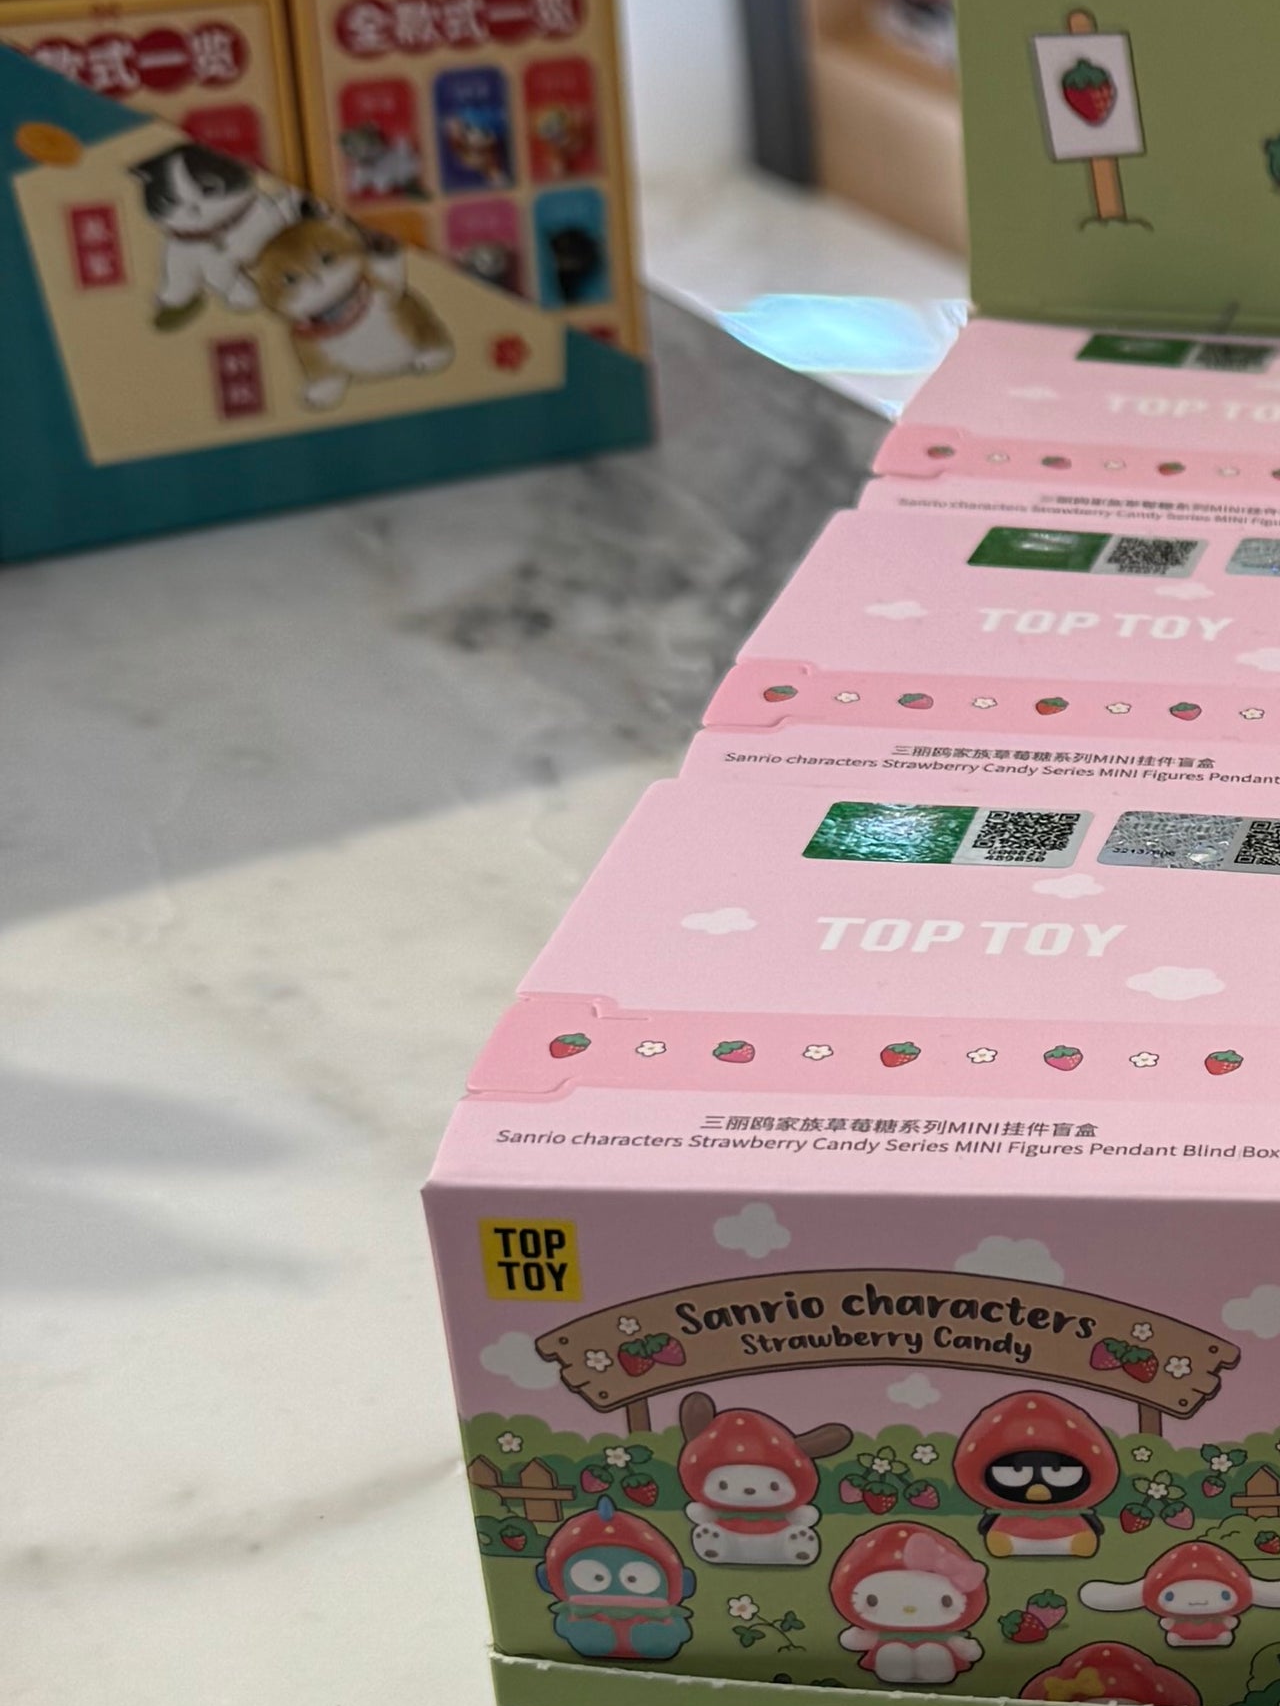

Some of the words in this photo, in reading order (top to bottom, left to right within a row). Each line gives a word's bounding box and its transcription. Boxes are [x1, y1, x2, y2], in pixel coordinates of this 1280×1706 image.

[1105, 394, 1206, 419] TOP
[978, 607, 1100, 637] TOP
[1112, 611, 1234, 641] TOY
[724, 753, 782, 764] Sanrio
[786, 755, 877, 768] characters
[882, 759, 979, 776] Strawberry
[982, 763, 1038, 779] Candy
[1042, 765, 1095, 777] Series
[1098, 768, 1138, 779] MINI
[1142, 769, 1204, 784] Figures
[1209, 772, 1280, 785] Pendant
[818, 917, 964, 955] TOP
[980, 919, 1128, 959] TOY
[497, 1130, 566, 1144] Sanrio
[571, 1131, 683, 1146] characters
[689, 1134, 807, 1154] Strawberry
[813, 1136, 880, 1155] Candy
[886, 1138, 949, 1152] Series
[955, 1139, 1002, 1153] MINI
[1008, 1141, 1083, 1158] Figures
[1089, 1142, 1176, 1156] Pendant
[1183, 1144, 1235, 1158] Blind
[1241, 1146, 1280, 1158] Box
[493, 1229, 566, 1257] TOP
[497, 1261, 568, 1292] TOY
[674, 1289, 825, 1338] Sanrio
[842, 1285, 1097, 1340] characters
[741, 1327, 924, 1357] Strawberry
[934, 1326, 1033, 1362] Candy
